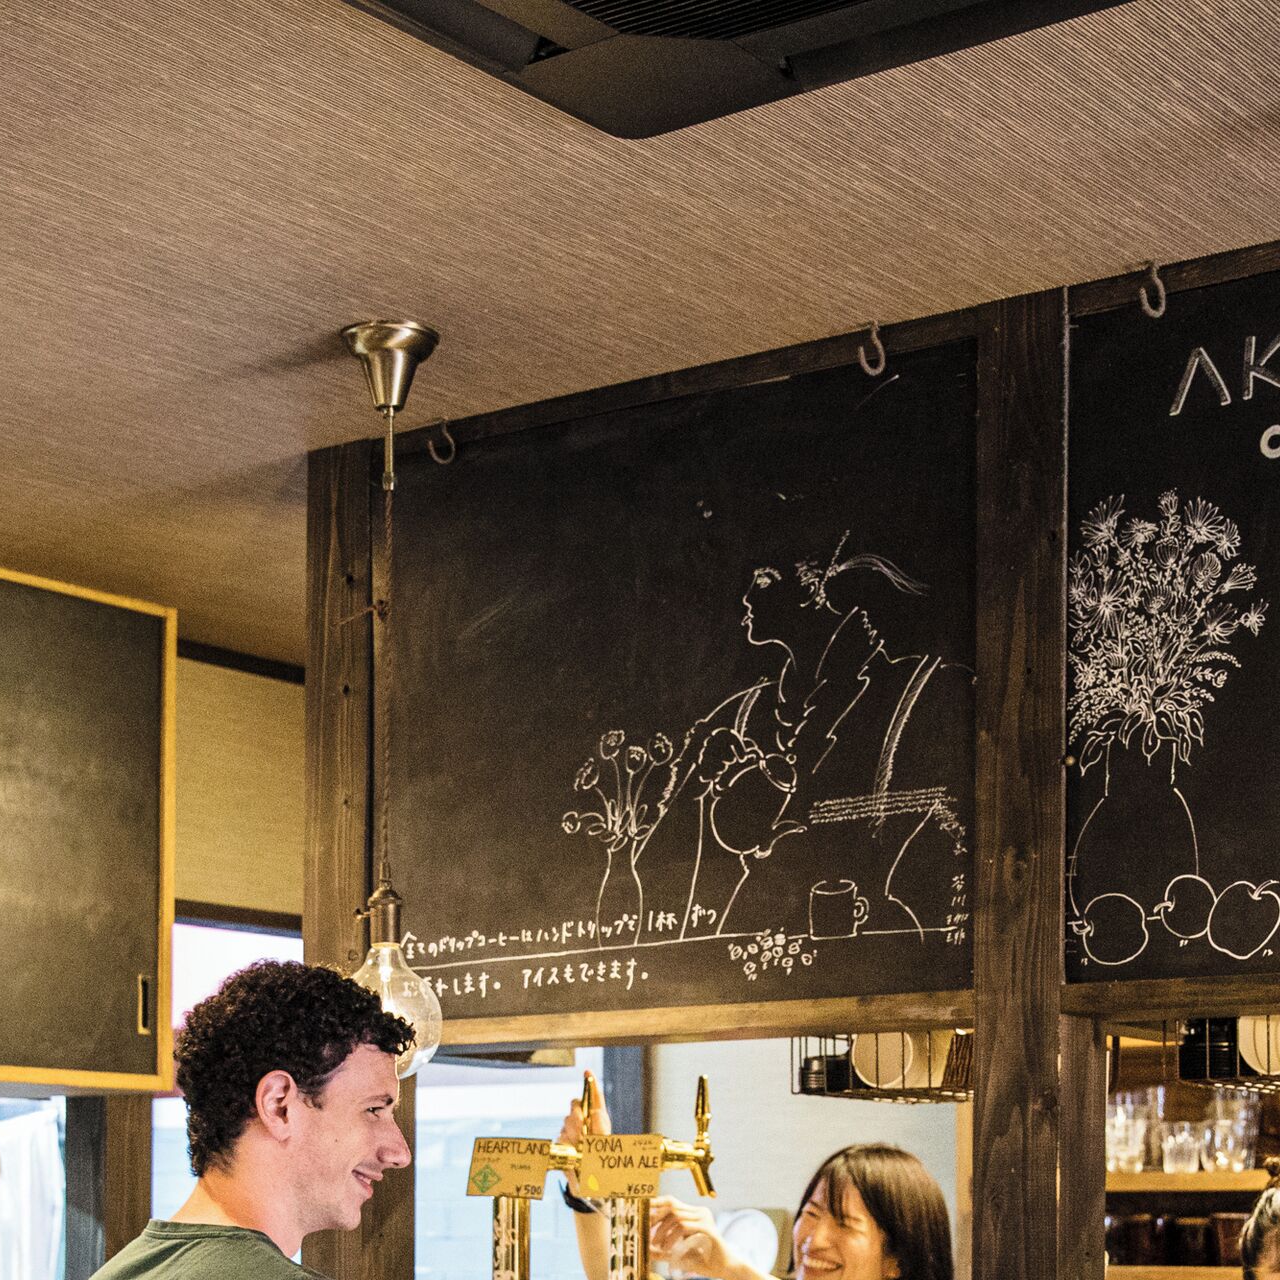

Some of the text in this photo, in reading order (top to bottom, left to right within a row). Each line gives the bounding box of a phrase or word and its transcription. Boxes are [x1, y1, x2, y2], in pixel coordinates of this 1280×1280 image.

[477, 1140, 552, 1156] HEARTLAND
[585, 1138, 623, 1153] YONA
[598, 1155, 659, 1169] YONA ALE
[627, 1183, 655, 1196] ¥650
